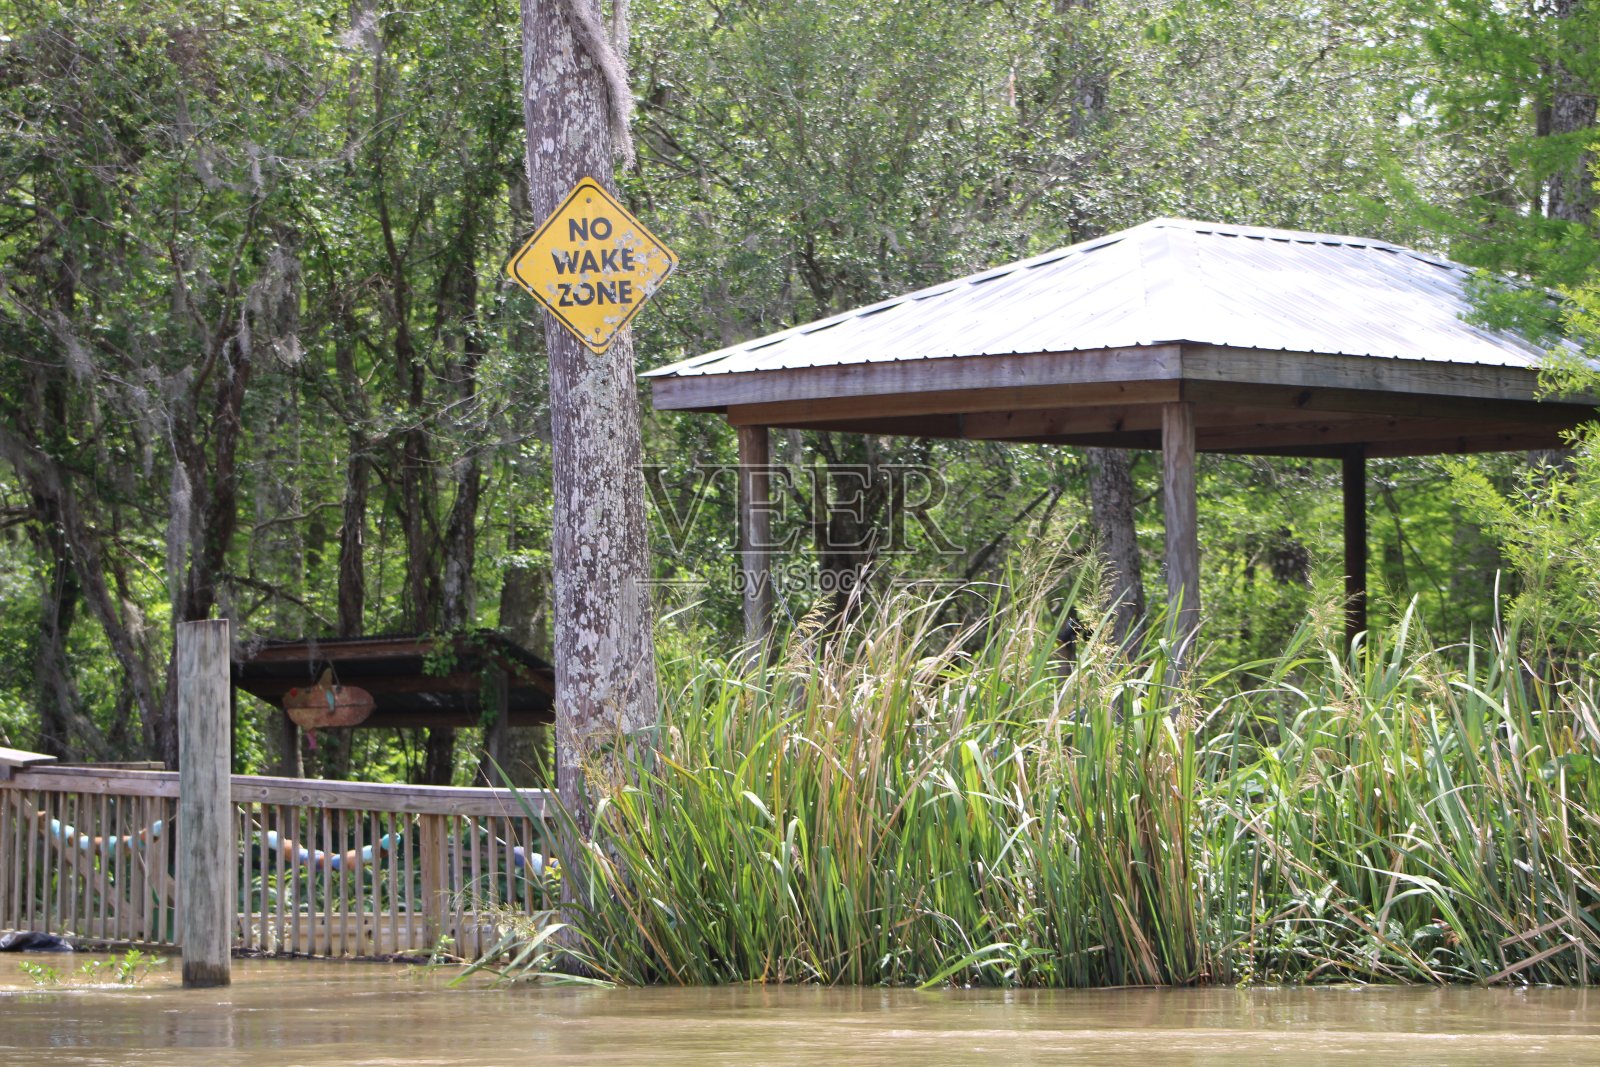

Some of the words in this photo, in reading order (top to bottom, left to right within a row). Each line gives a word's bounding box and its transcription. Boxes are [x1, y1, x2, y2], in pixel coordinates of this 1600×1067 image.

[569, 217, 613, 242] NO
[551, 248, 635, 275] WAKE
[557, 280, 632, 307] ZONE
